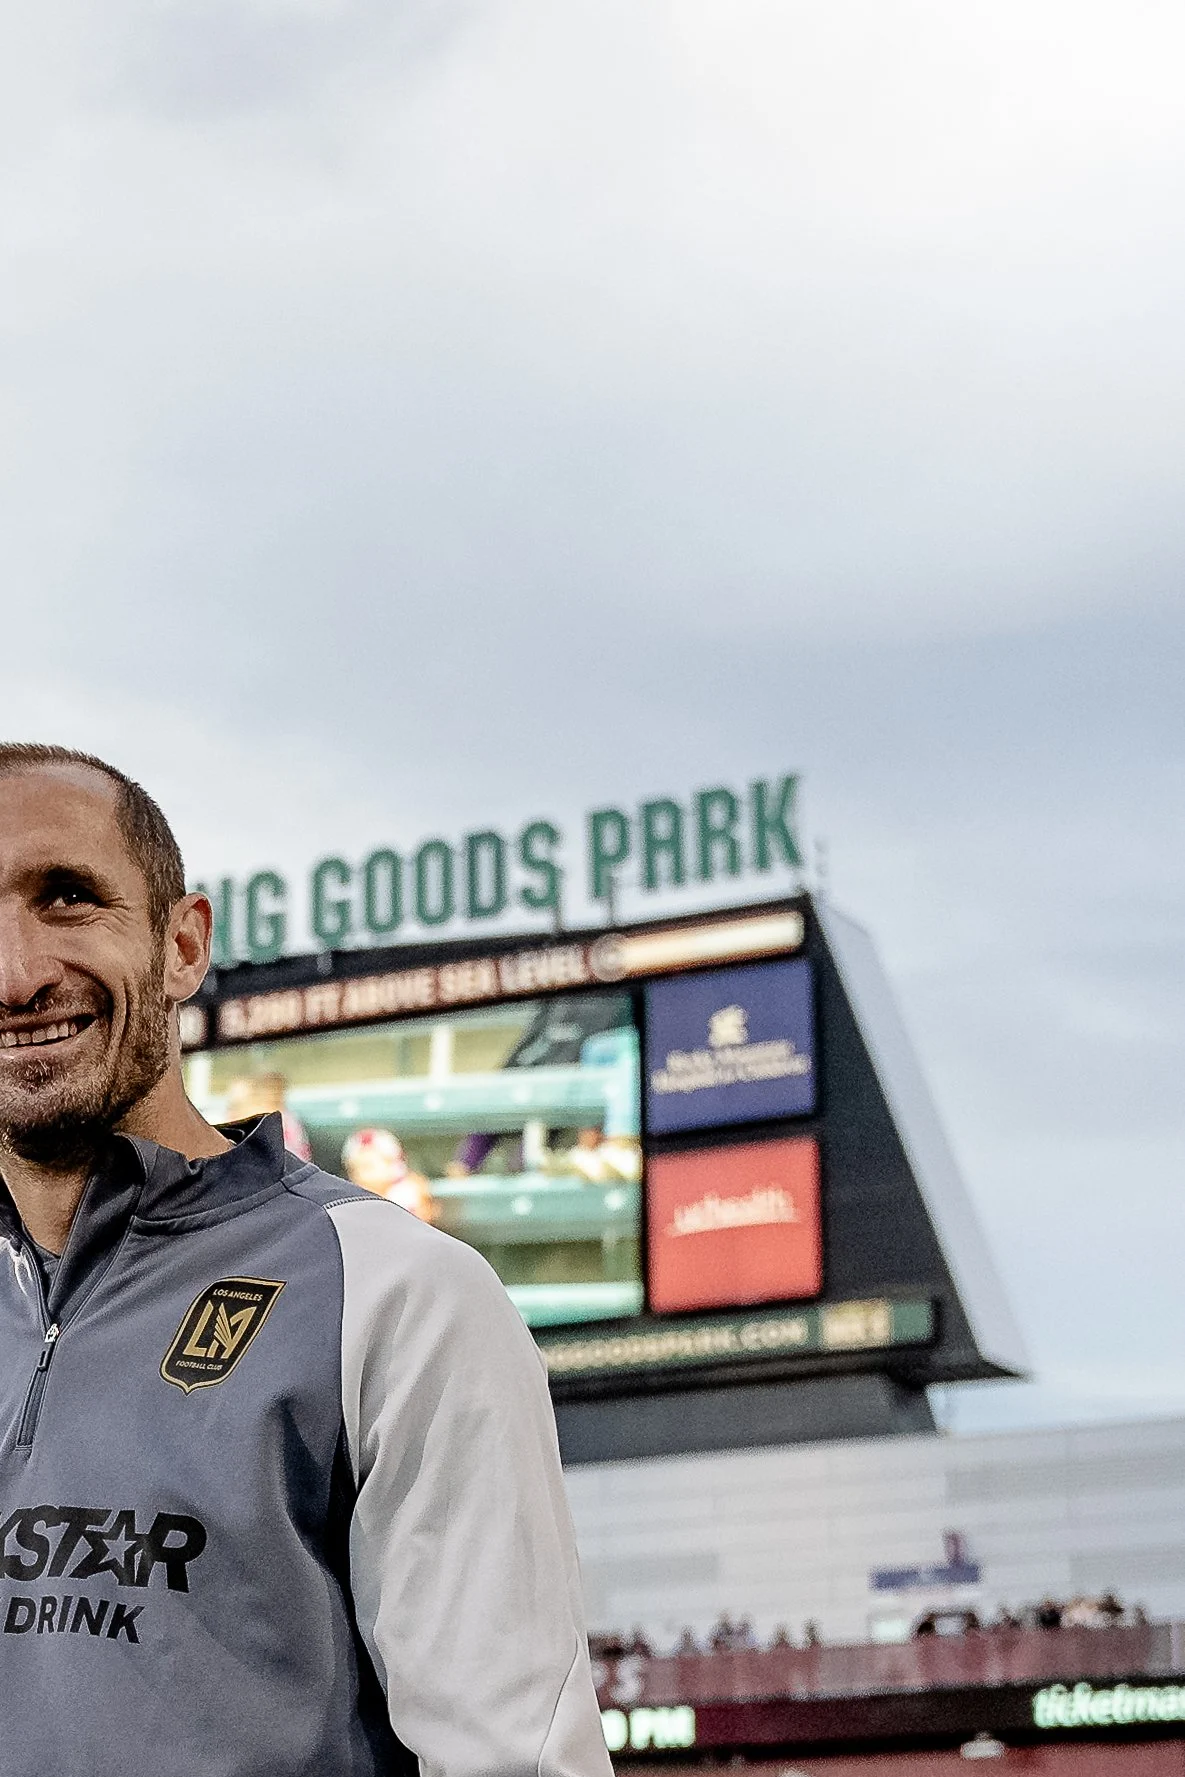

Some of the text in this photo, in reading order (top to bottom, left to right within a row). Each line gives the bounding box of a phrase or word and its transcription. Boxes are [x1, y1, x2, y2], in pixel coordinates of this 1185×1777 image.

[312, 822, 562, 950] GOODS
[586, 774, 804, 900] PARK
[499, 944, 585, 991] LEVEL
[212, 1288, 263, 1301] LOS ANGELES
[175, 1360, 223, 1371] FOOTBALL CLUB
[4, 1595, 146, 1645] DRINK
[630, 1706, 695, 1750] PM
